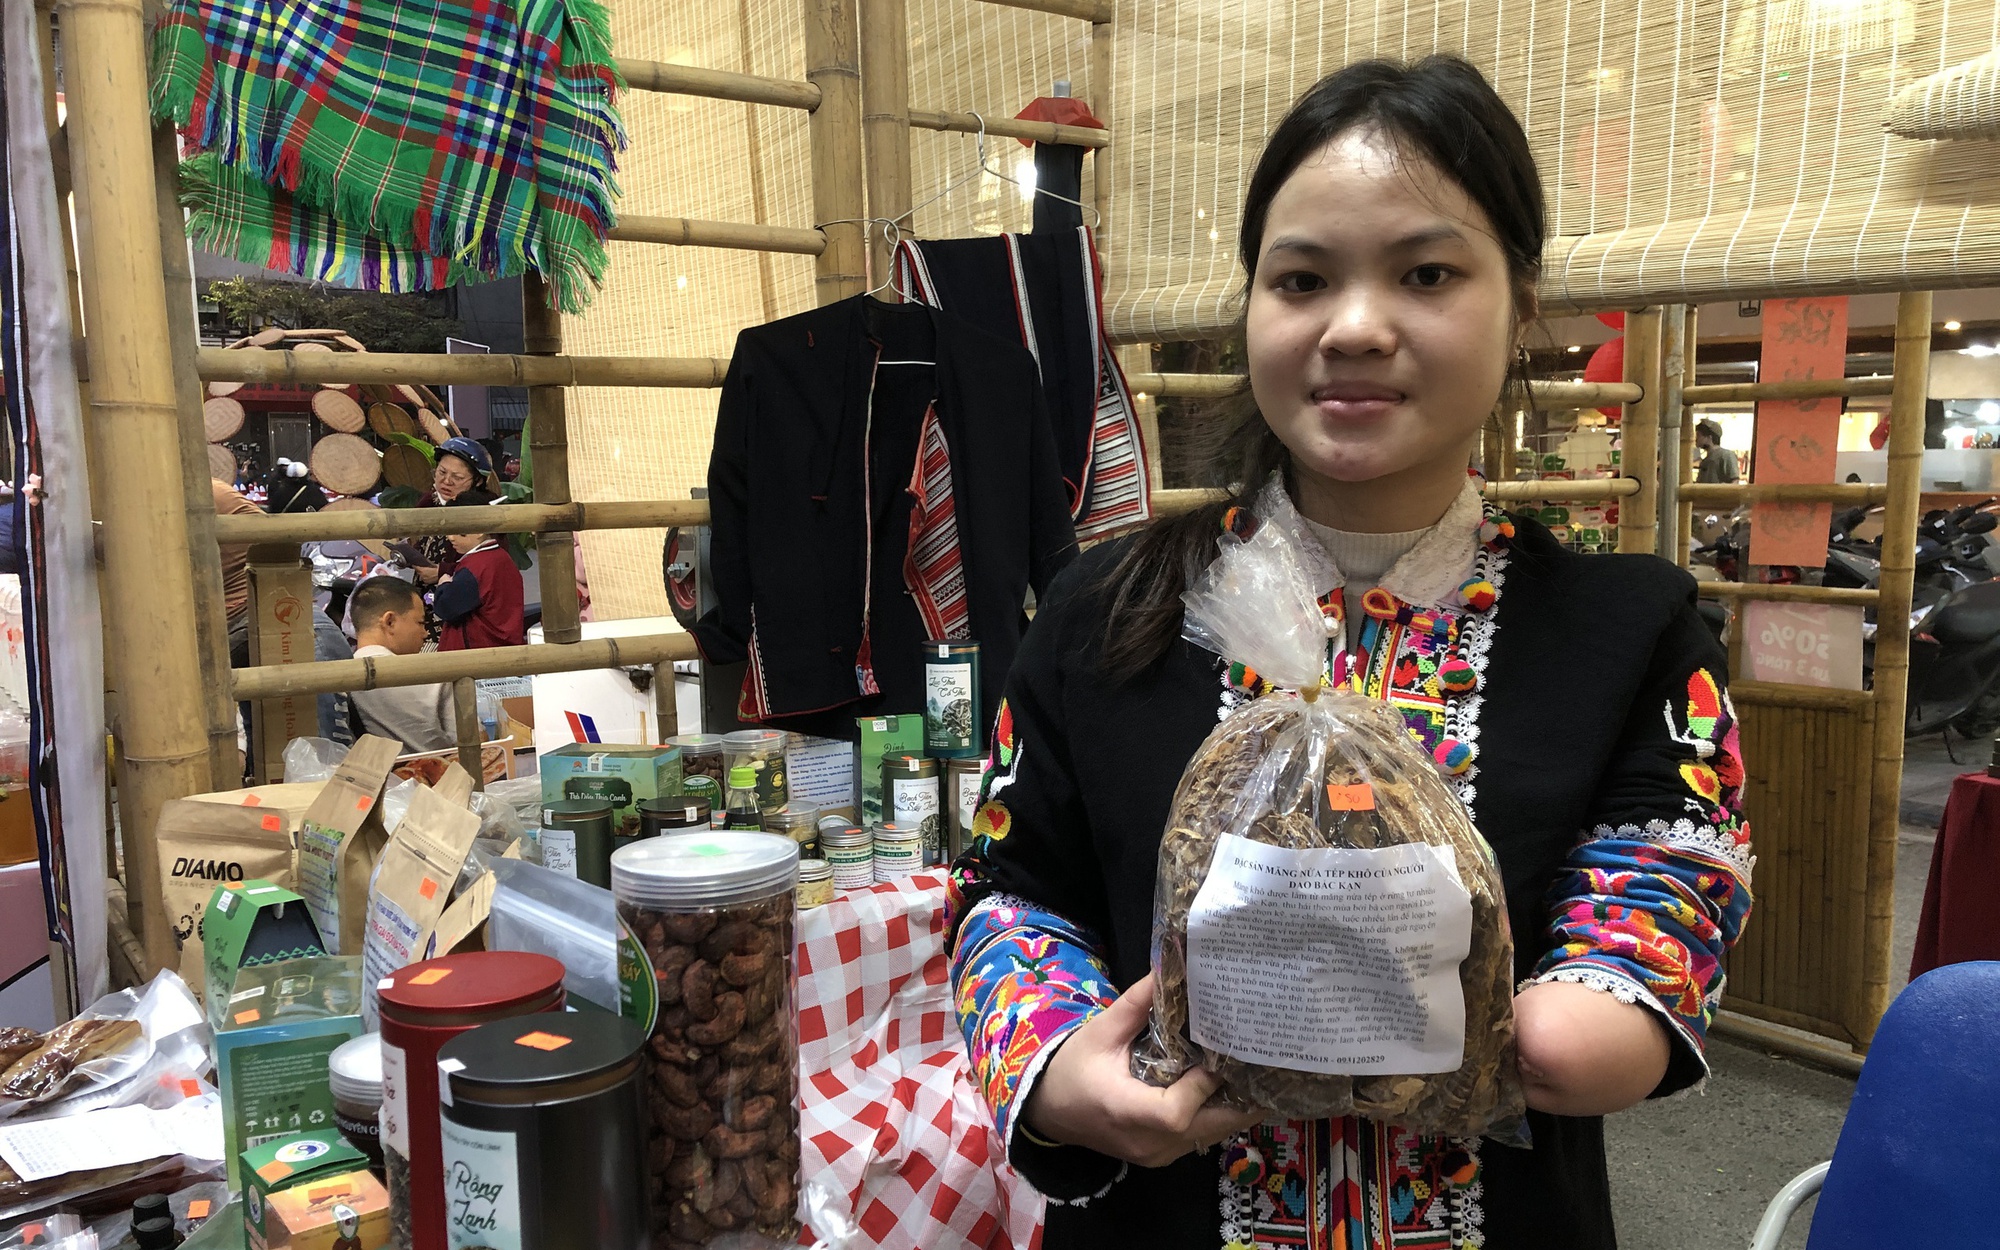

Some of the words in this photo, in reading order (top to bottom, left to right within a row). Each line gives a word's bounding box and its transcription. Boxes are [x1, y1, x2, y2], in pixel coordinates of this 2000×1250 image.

[171, 857, 244, 882] DIAMO
[1265, 865, 1297, 878] MĂNG
[1289, 881, 1312, 890] DAO
